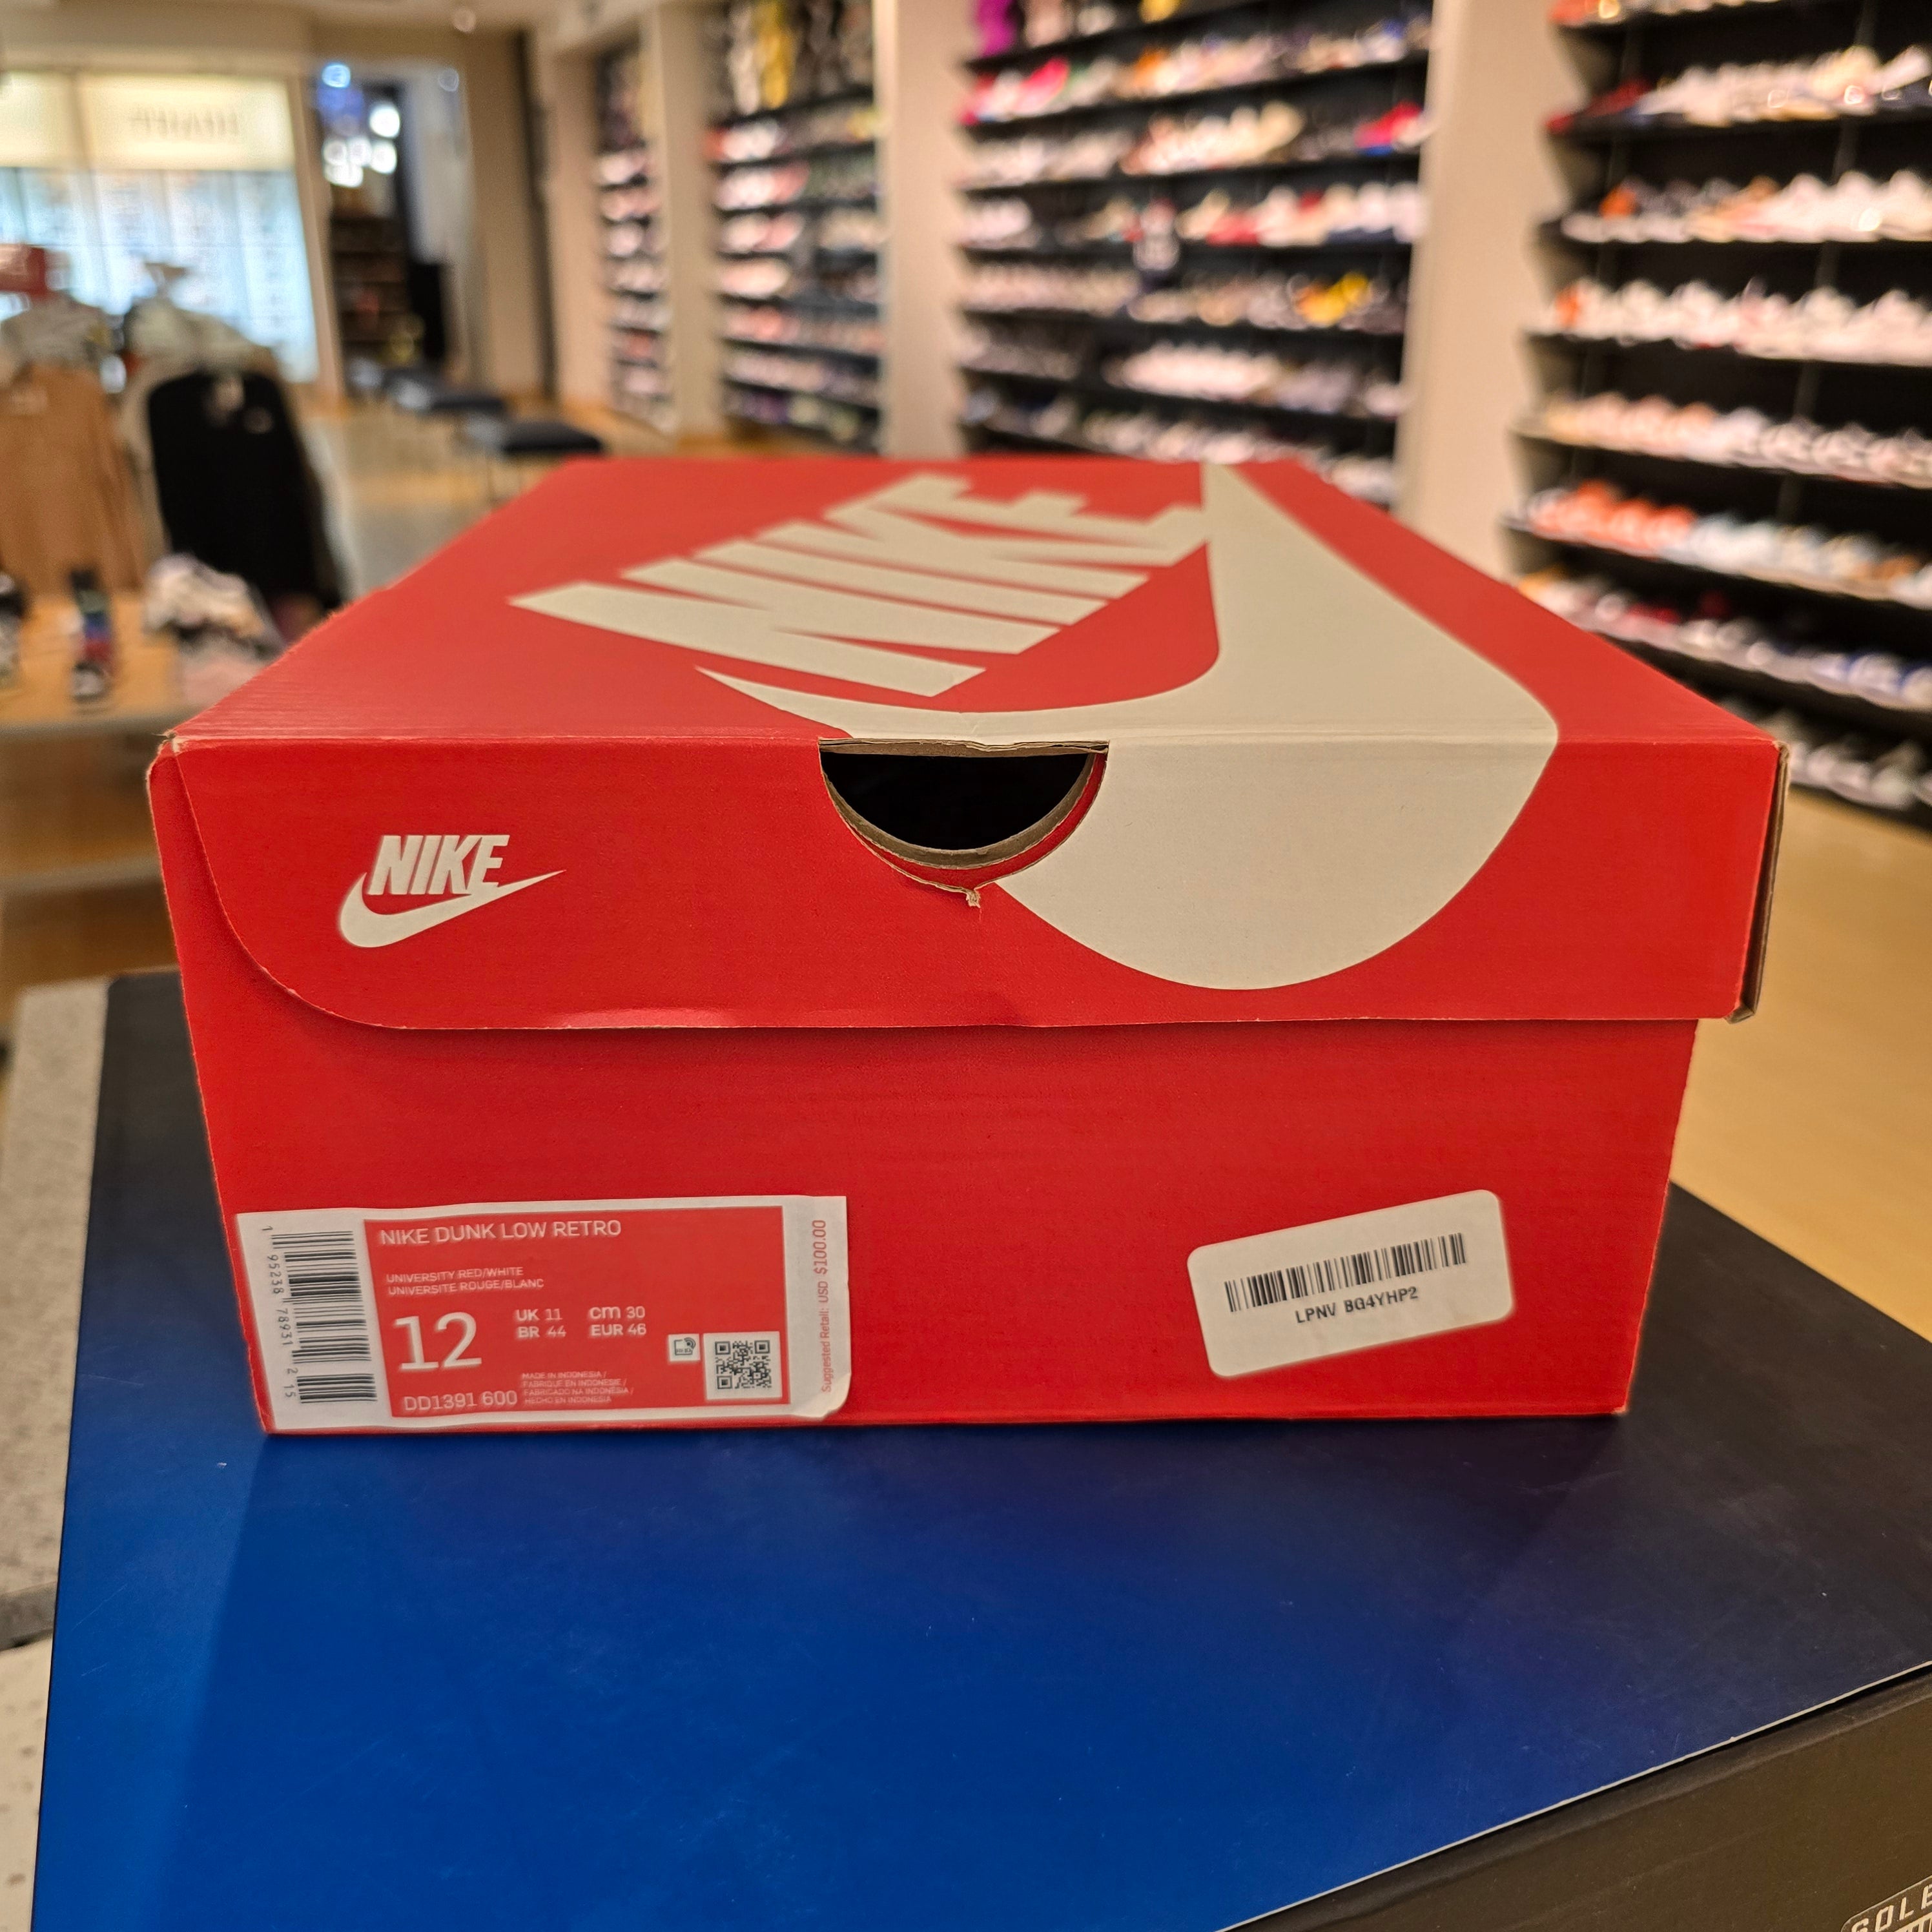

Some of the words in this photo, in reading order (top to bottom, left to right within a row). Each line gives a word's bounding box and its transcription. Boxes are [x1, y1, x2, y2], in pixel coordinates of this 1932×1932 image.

[508, 472, 1208, 697] NIKE
[367, 835, 510, 896] NIKE
[380, 1228, 430, 1245] NIKE
[435, 1223, 497, 1242] DUNK
[501, 1221, 547, 1239] LOW
[553, 1220, 622, 1237] RETRO
[812, 1220, 828, 1275] $100.00
[267, 1254, 285, 1295] 95238
[386, 1270, 455, 1283] UNIVERSITY
[458, 1267, 524, 1279] RED/WHITE
[388, 1282, 458, 1295] UNIVERSITE
[460, 1278, 544, 1291] ROUGE/BLANC
[817, 1281, 828, 1303] USD
[516, 1308, 540, 1321] UK
[544, 1308, 563, 1321] 11
[589, 1306, 621, 1319] cm
[626, 1306, 645, 1319] 30
[1295, 1302, 1336, 1324] LPNV
[1343, 1286, 1419, 1313] BG4YHP2
[276, 1308, 294, 1346] 78931
[518, 1326, 540, 1339] BR
[548, 1325, 566, 1337] 44
[590, 1324, 624, 1337] EUR
[628, 1323, 646, 1335] 46
[395, 1311, 482, 1370] 12
[821, 1341, 834, 1393] Suggested
[283, 1384, 296, 1398] 15
[523, 1379, 563, 1388] FABRIQUE
[578, 1378, 621, 1386] INDONESIE
[404, 1392, 477, 1411] DD1391
[482, 1390, 518, 1406] 600
[525, 1396, 553, 1404] HECHO
[568, 1395, 612, 1404] INDONESIA
